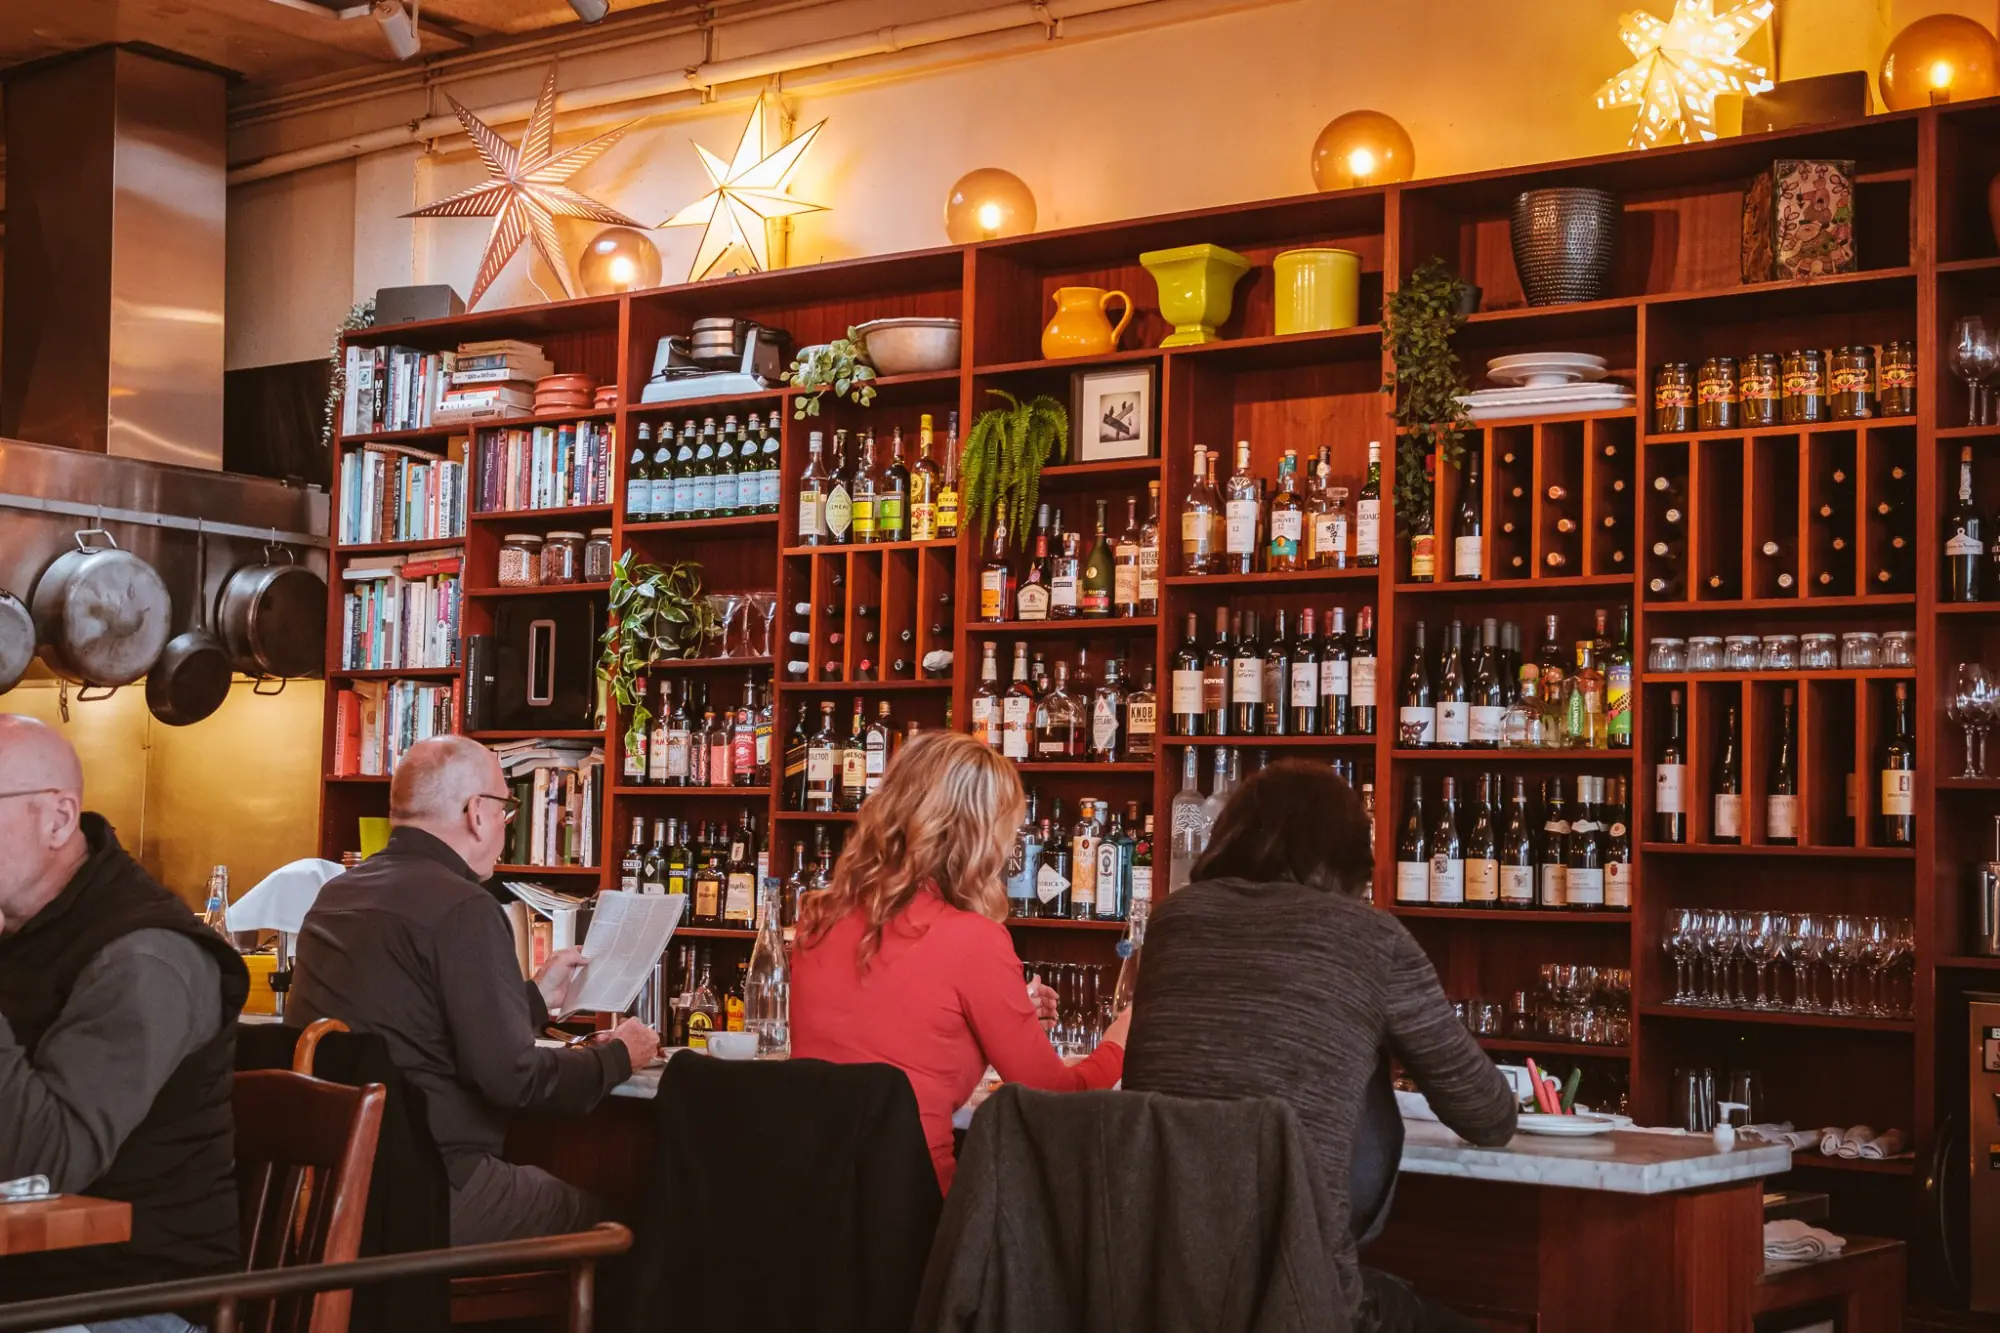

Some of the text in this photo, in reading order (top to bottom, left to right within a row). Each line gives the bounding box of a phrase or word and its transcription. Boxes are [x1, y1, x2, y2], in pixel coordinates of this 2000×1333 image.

[375, 379, 383, 417] MEAT
[598, 434, 607, 502] WINE BIBLE
[1131, 706, 1153, 718] KNOB
[1267, 703, 1274, 712] H
[755, 725, 773, 736] PEROL
[809, 752, 829, 761] LETON
